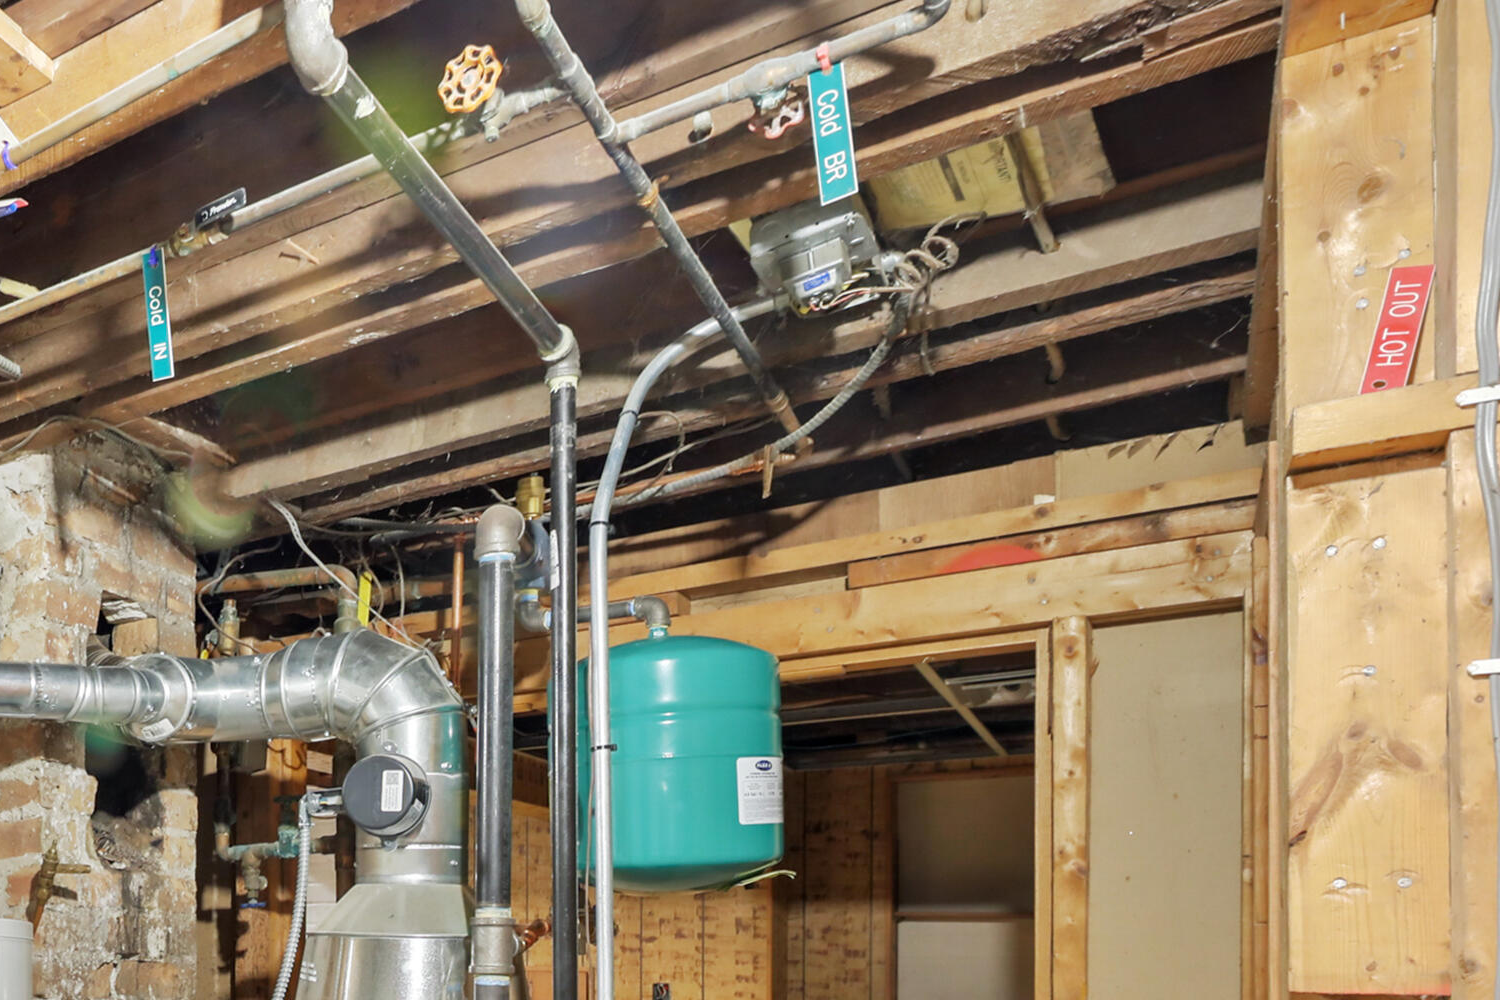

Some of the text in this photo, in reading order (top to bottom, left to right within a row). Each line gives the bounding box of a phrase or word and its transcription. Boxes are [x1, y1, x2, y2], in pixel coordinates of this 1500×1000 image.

[817, 89, 848, 184] Cold BR
[148, 286, 168, 360] Cold IN
[1375, 280, 1422, 366] HOT OUT
